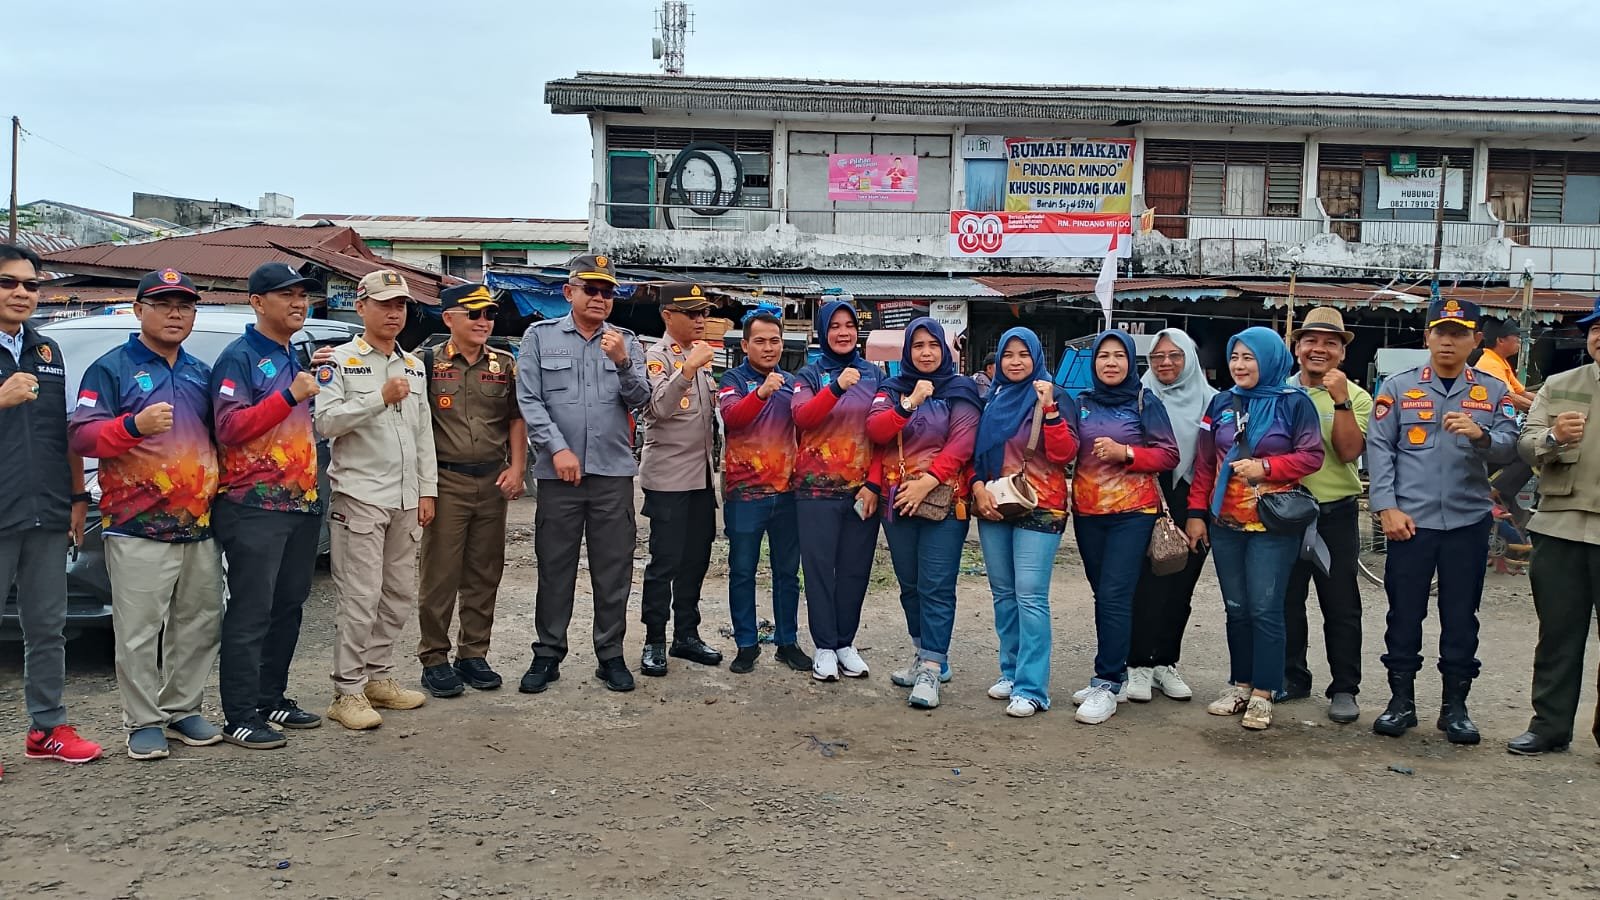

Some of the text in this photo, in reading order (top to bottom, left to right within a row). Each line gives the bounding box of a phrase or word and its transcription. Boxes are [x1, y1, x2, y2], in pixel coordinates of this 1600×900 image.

[1010, 142, 1130, 160] RUMAH MAKAN
[1009, 181, 1126, 195] KHUSUS PINDANG IKAN
[1401, 190, 1434, 198] HUBUNGI
[1077, 199, 1094, 208] 1976
[1410, 200, 1429, 208] 7910
[958, 214, 1003, 253] 80
[1117, 321, 1145, 335] RM
